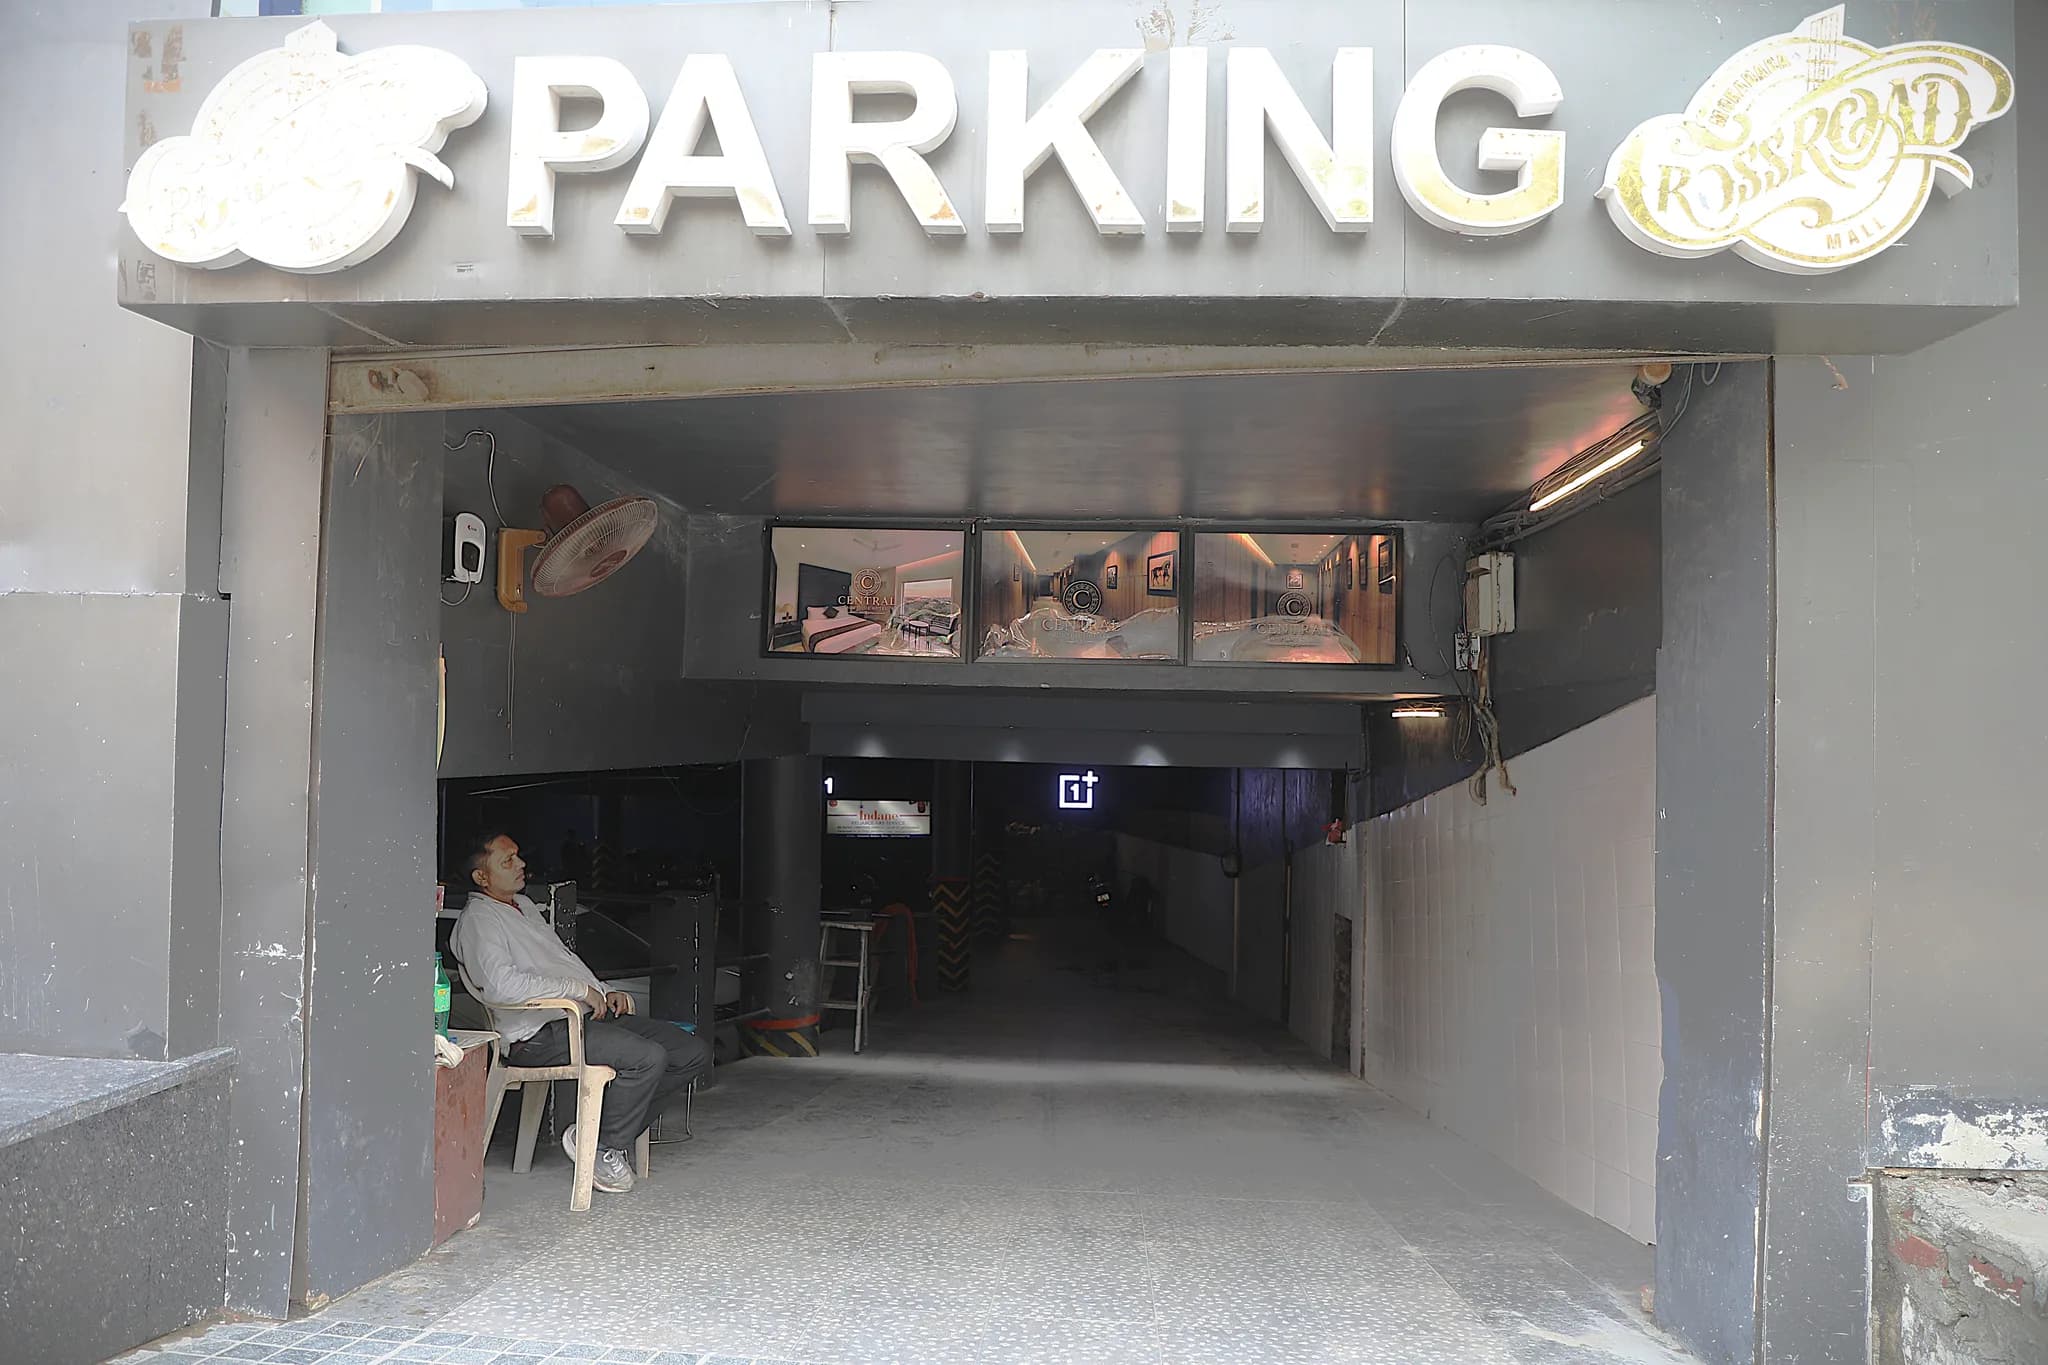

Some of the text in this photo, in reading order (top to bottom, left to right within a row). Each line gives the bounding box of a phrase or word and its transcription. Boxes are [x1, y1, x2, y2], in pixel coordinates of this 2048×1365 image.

[507, 44, 1566, 238] PARKING
[1825, 216, 1889, 251] MALL
[837, 595, 896, 606] CENTRAL
[859, 808, 898, 821] Indane
